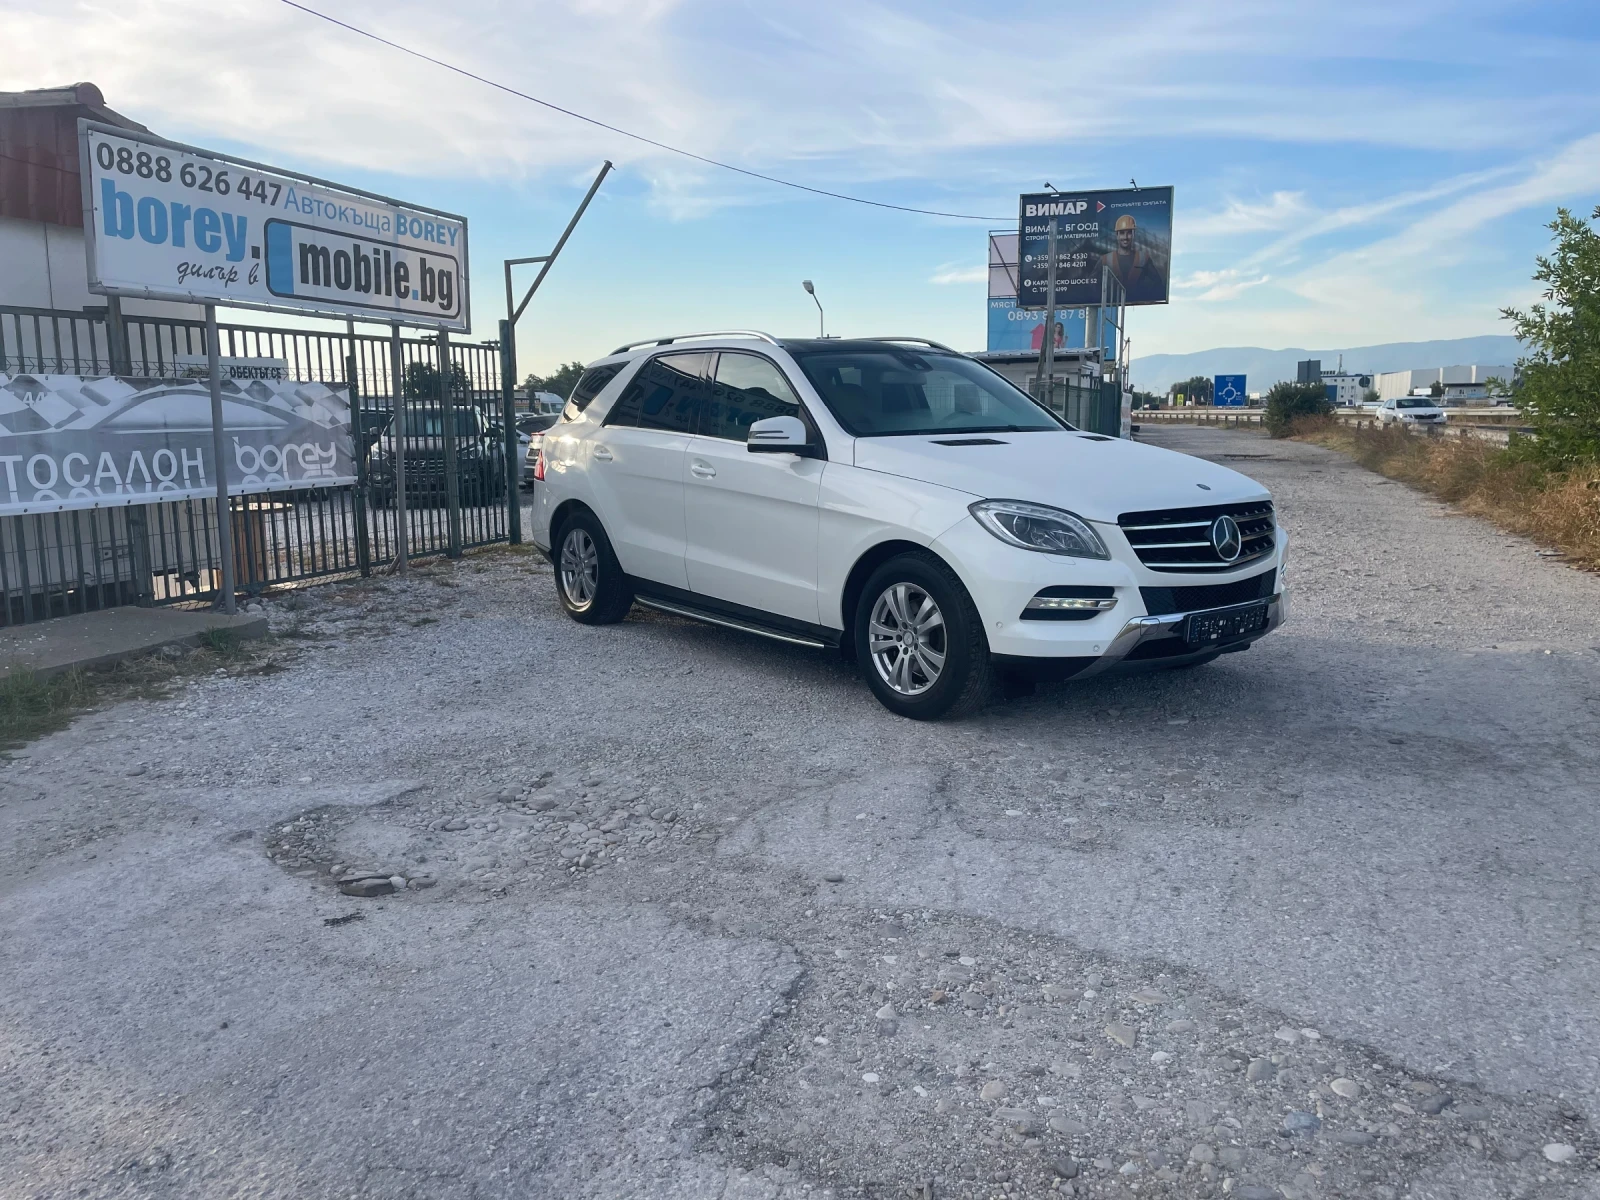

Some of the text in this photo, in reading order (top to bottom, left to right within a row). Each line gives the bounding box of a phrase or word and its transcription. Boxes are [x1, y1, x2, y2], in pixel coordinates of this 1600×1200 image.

[96, 142, 282, 207] 0888 626 447
[1025, 201, 1088, 217] ВИМАР
[396, 213, 460, 247] BOREY
[1025, 225, 1051, 234] ВИМА
[1065, 223, 1076, 232] БГ
[1077, 222, 1099, 231] ООД
[299, 242, 453, 311] mobile.bg
[990, 301, 1017, 309] МЯСТ
[1007, 311, 1039, 321] 0893
[1060, 309, 1074, 320] 87
[0, 447, 206, 491] ТОСАЛОН
